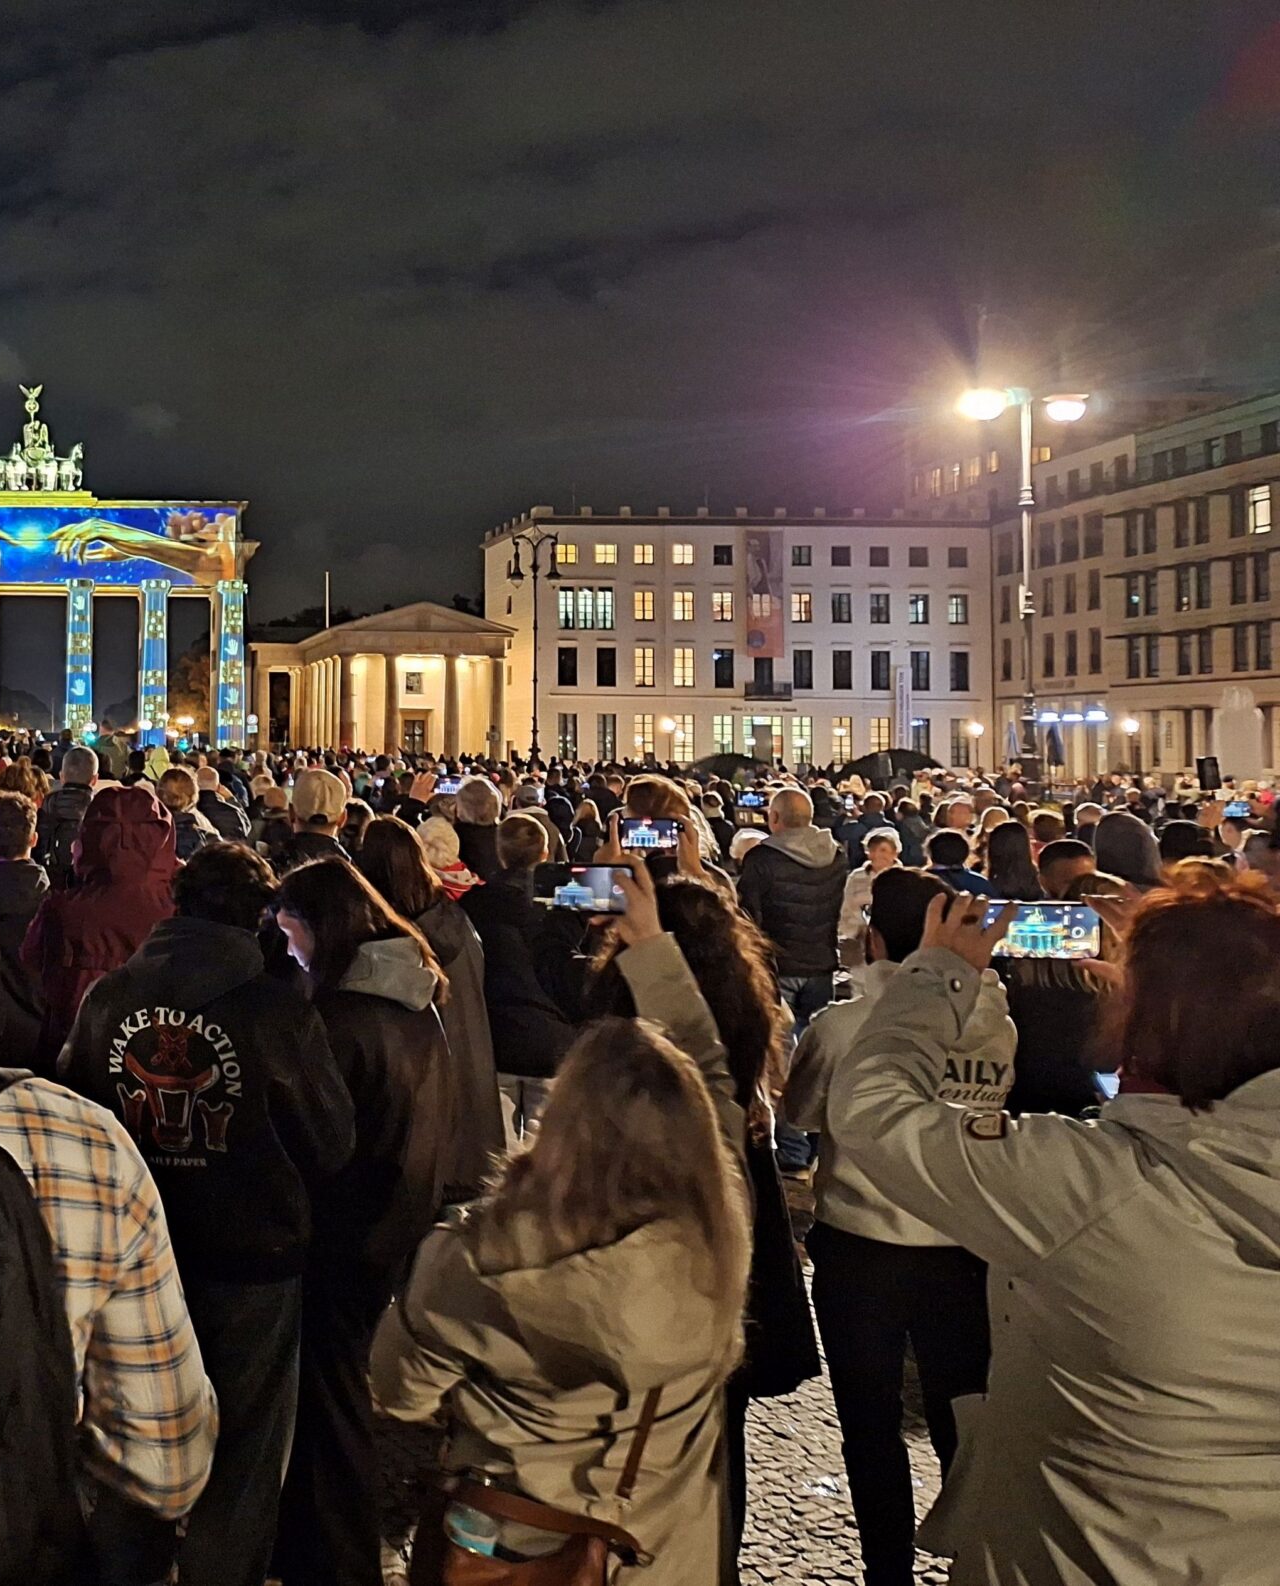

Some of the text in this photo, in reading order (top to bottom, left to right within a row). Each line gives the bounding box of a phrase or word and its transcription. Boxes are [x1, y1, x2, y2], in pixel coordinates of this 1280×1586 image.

[109, 1006, 243, 1098] WAKE TO ACTION
[941, 1058, 1009, 1086] AILY
[173, 1157, 207, 1168] PAPER
